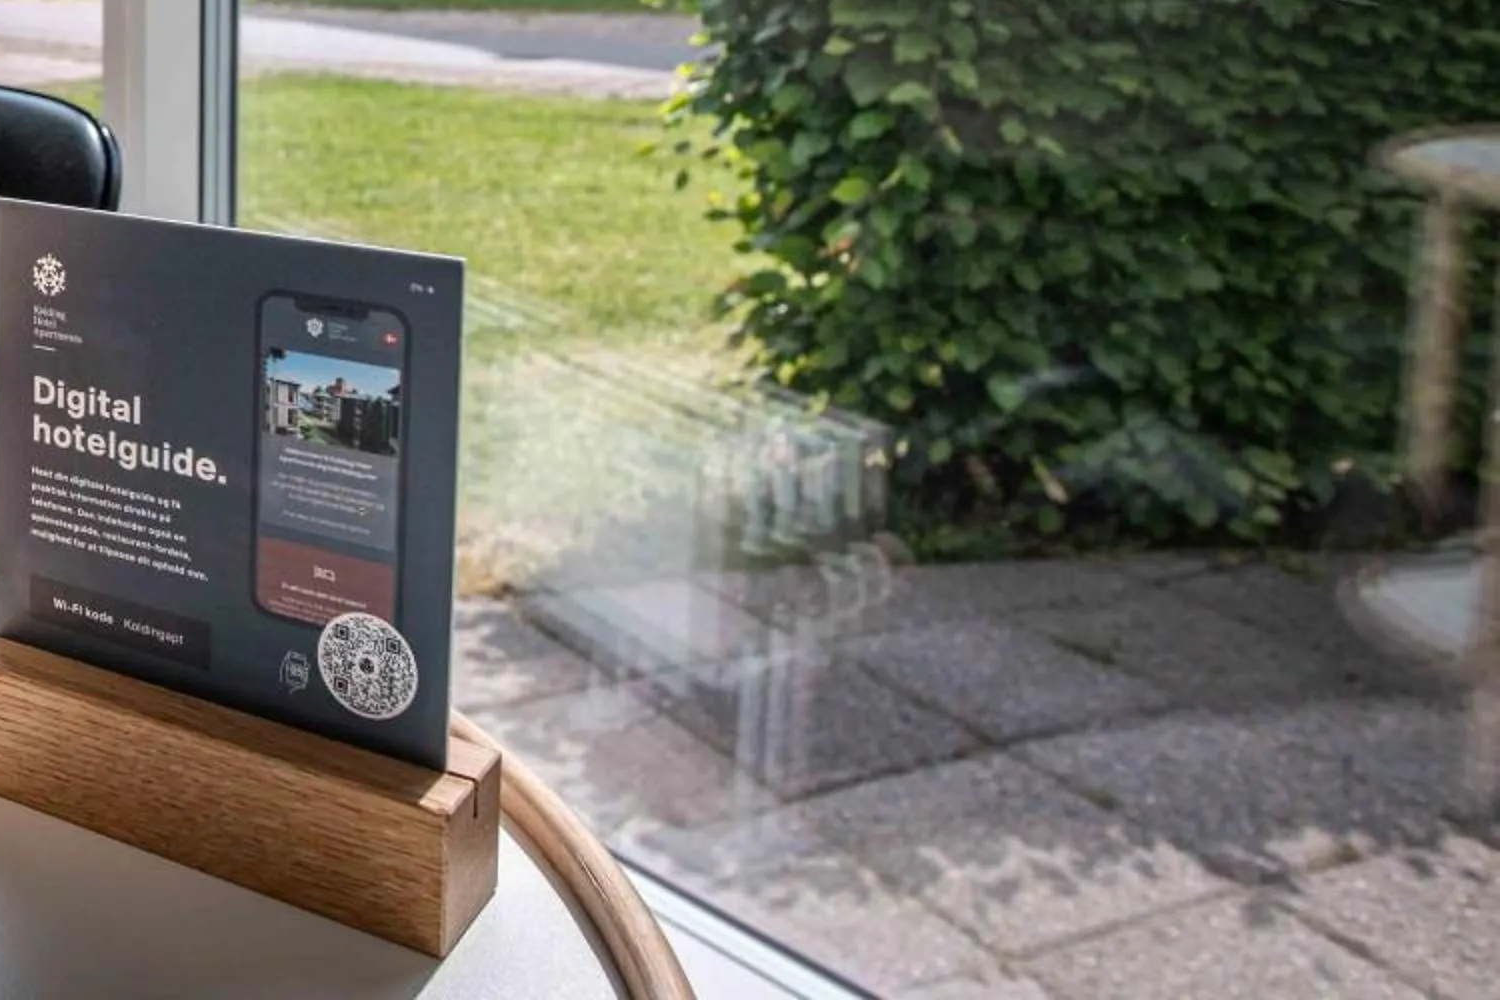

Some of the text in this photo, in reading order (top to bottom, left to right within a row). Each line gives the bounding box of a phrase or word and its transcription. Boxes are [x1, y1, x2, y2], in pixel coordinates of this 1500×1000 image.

[33, 375, 142, 425] Digital
[33, 413, 227, 485] hotelguide.
[105, 483, 155, 504] hotelguide
[53, 597, 84, 616] Wi-Fi
[85, 606, 115, 625] kode
